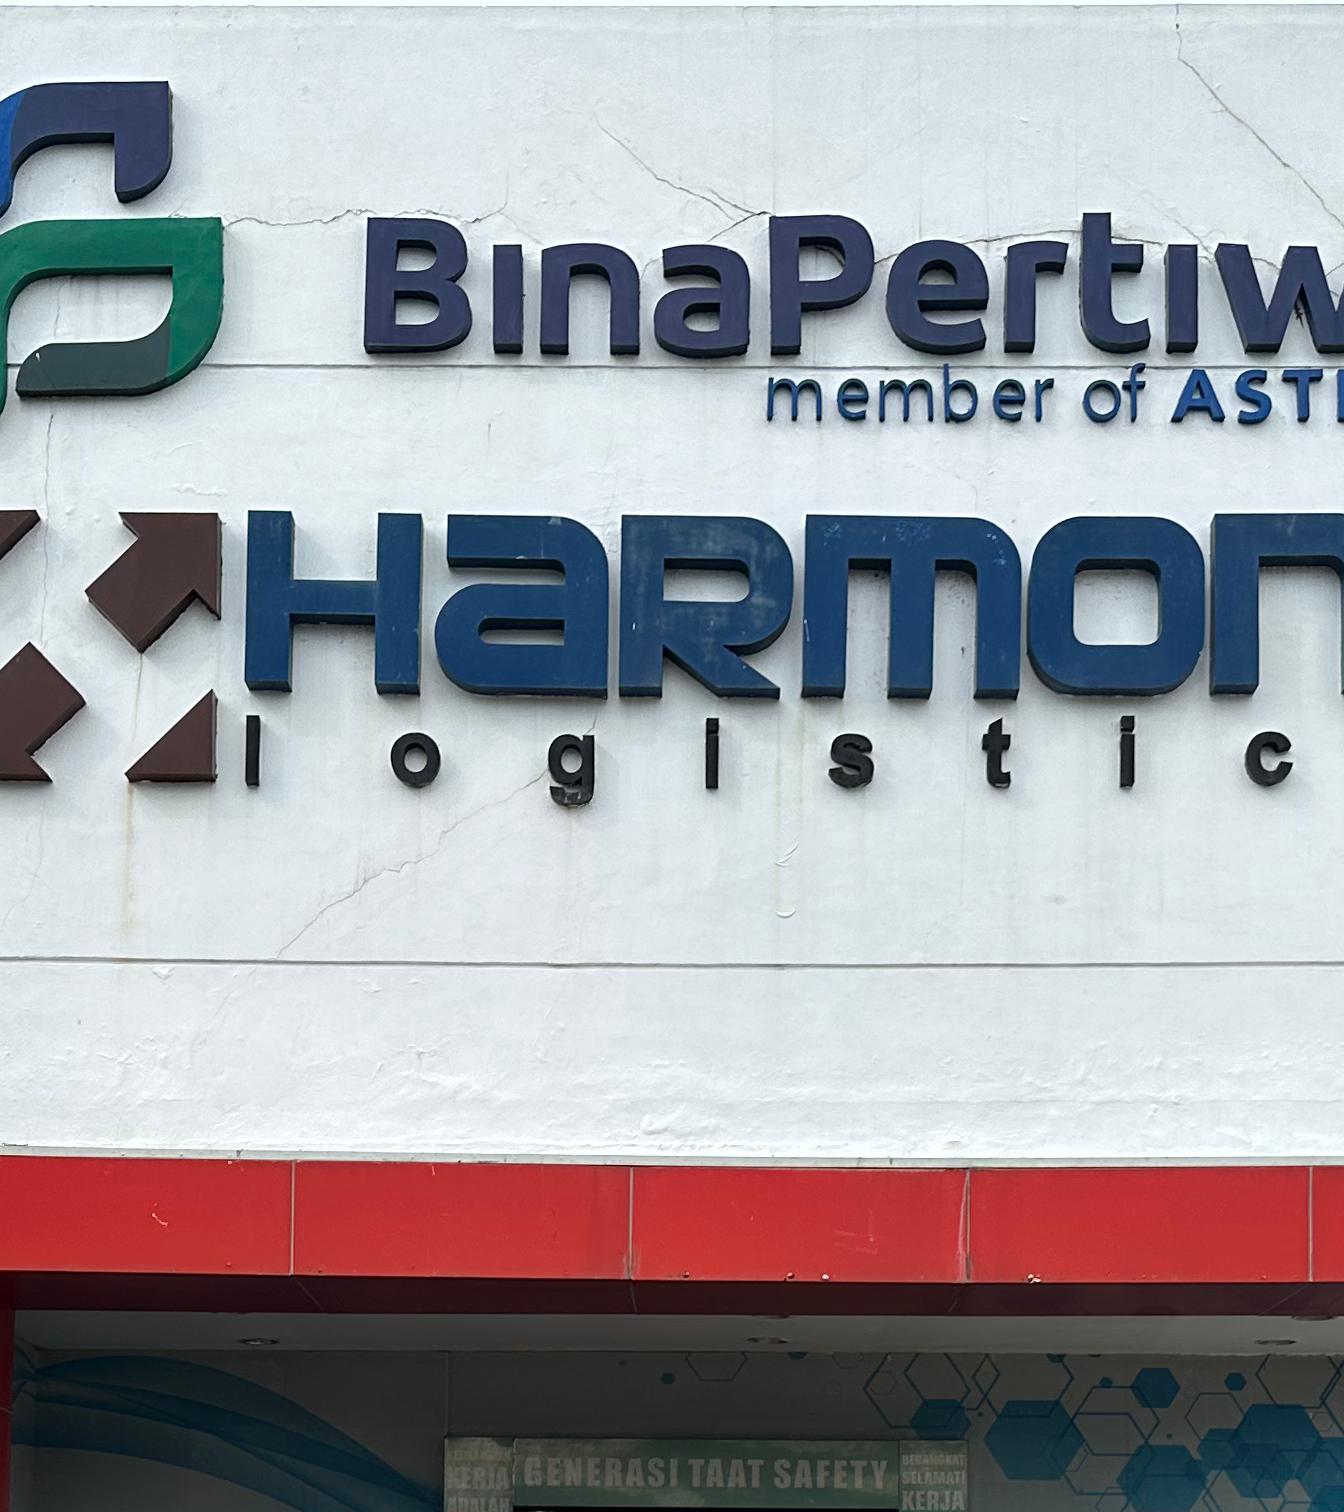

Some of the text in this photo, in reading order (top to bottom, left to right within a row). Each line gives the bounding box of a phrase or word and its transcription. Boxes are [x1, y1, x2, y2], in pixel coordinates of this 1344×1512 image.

[766, 364, 1054, 425] member
[1083, 362, 1147, 424] of
[524, 1457, 888, 1489] GENERASI TAAT SAFETY
[902, 1491, 965, 1511] KERJA
